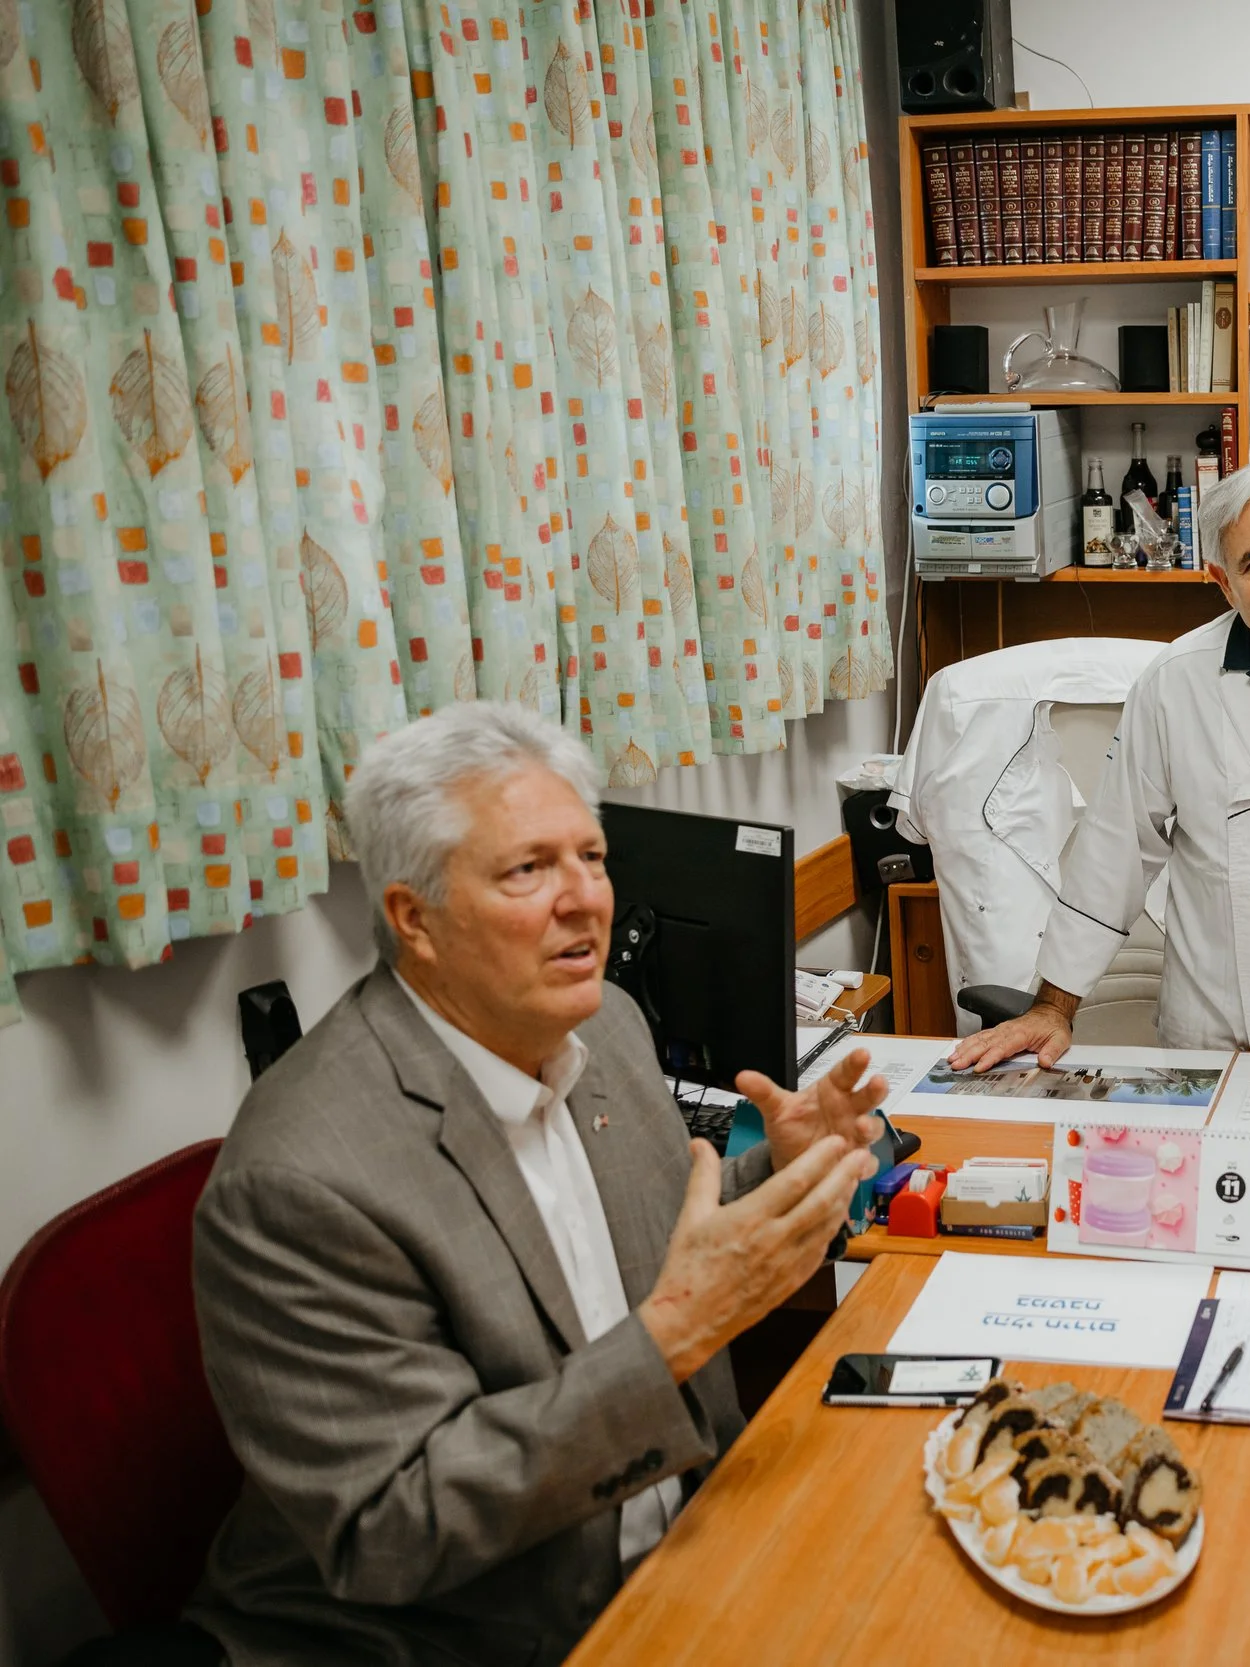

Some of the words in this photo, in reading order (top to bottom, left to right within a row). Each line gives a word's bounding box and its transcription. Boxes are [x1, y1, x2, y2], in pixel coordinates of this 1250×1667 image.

[1222, 1179, 1240, 1196] 11
[1016, 1297, 1101, 1310] במטבח
[980, 1314, 1033, 1330] נהלי
[1046, 1319, 1116, 1332] חירום
